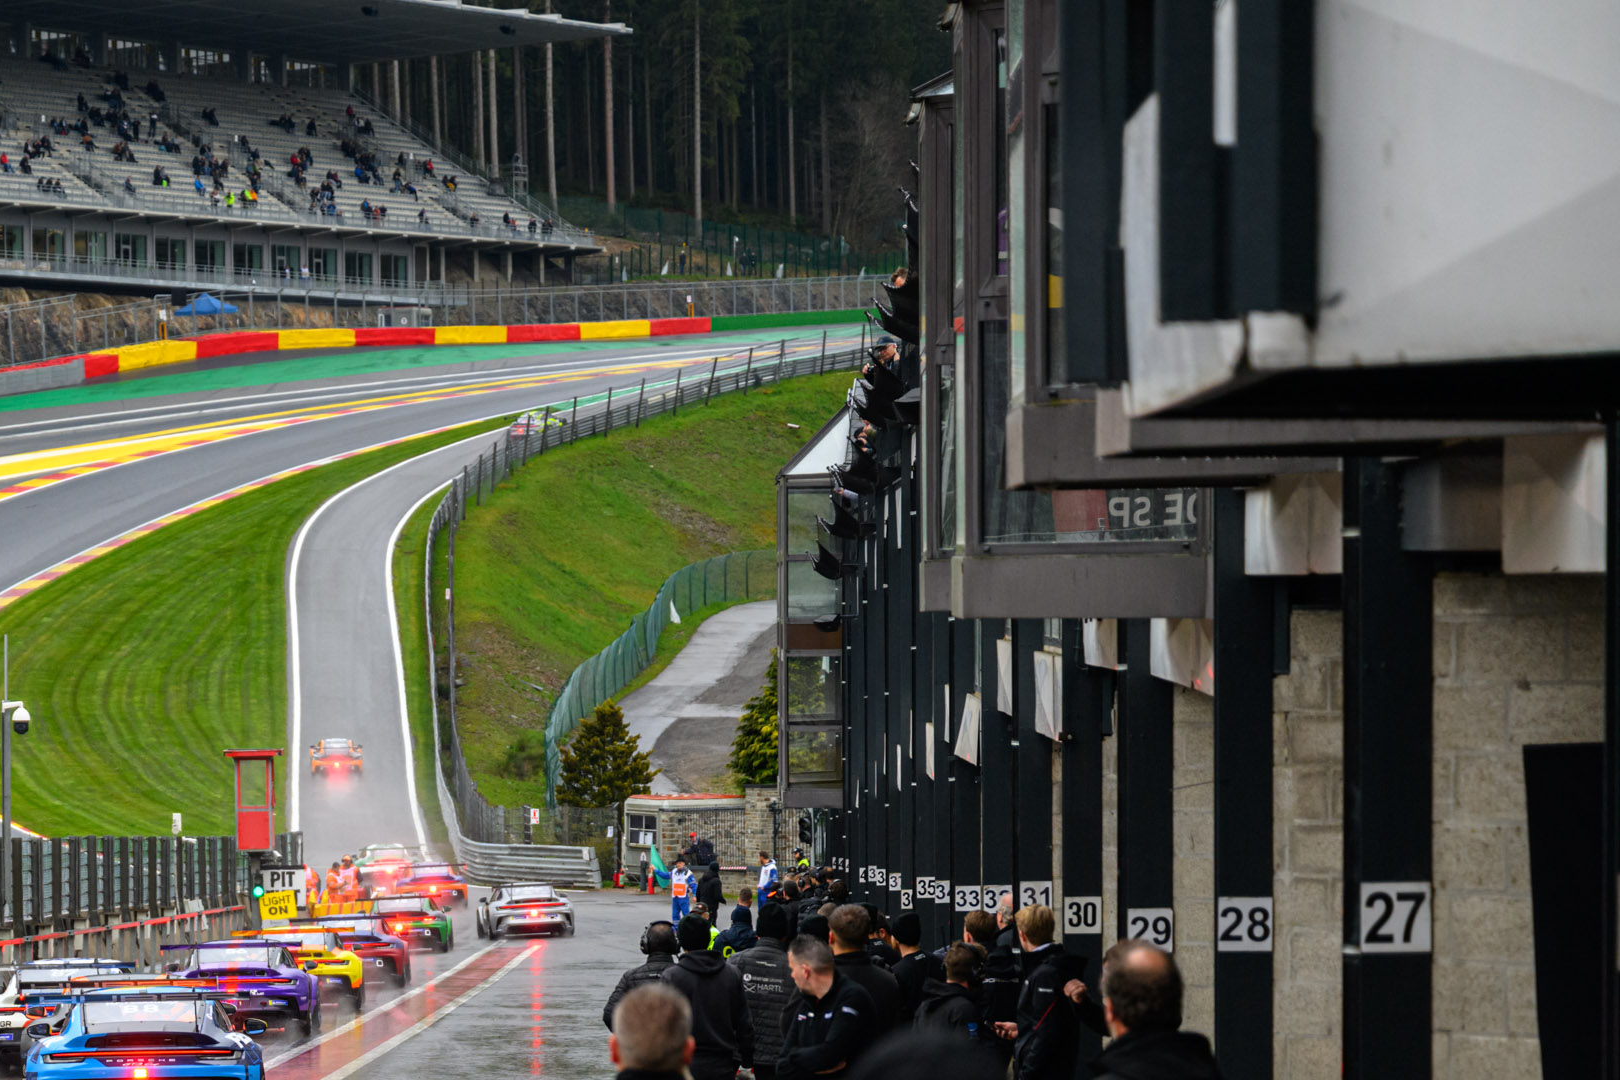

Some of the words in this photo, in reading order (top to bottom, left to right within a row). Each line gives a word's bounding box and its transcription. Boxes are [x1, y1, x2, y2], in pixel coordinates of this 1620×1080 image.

[270, 871, 295, 887] PIT
[918, 879, 935, 896] 35
[262, 894, 291, 907] LIGHT
[956, 890, 980, 907] 33
[1023, 886, 1050, 907] 31
[268, 905, 289, 916] ON
[1068, 902, 1097, 927] 30
[1364, 891, 1426, 944] 27
[1130, 916, 1172, 946] 29
[1219, 907, 1270, 943] 28
[757, 981, 783, 993] HARTL
